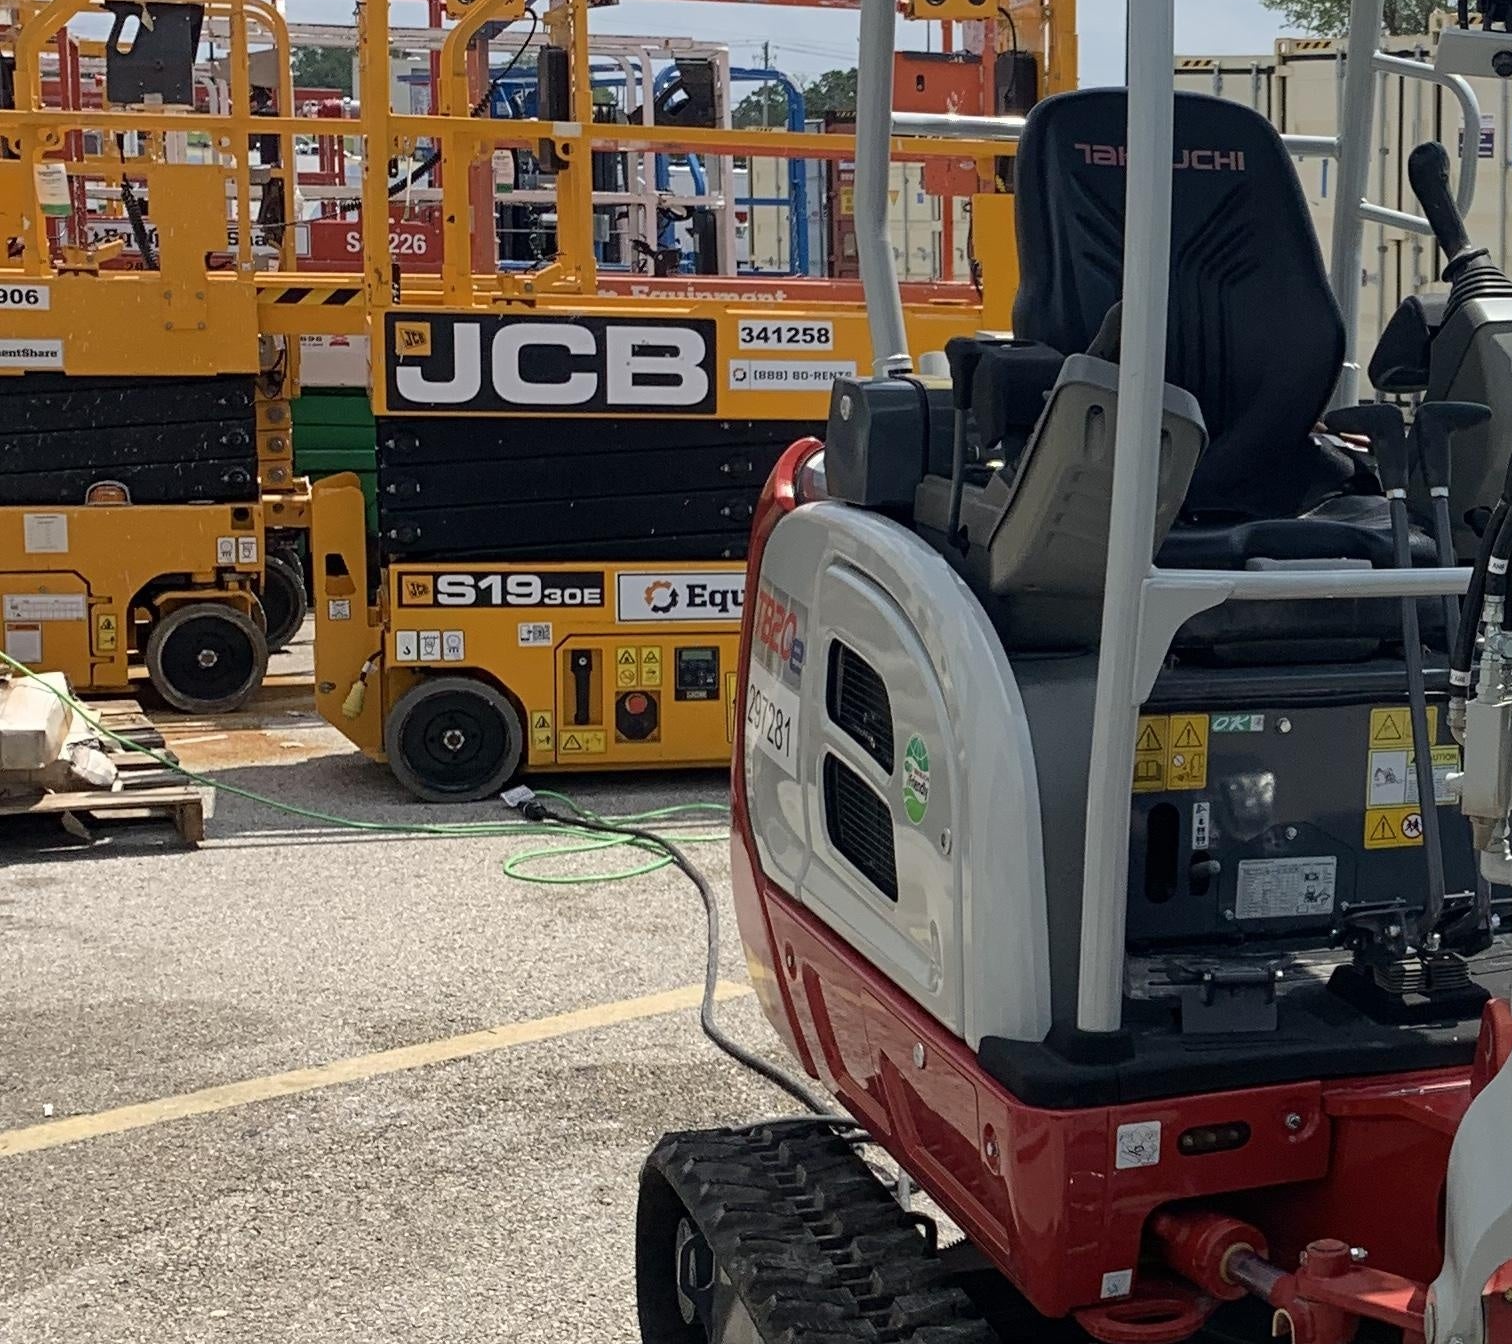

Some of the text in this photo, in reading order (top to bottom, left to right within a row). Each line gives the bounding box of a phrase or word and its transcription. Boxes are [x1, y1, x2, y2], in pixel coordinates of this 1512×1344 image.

[0, 348, 58, 358] entShare
[741, 327, 831, 344] 341258
[396, 322, 709, 405] JCB
[747, 683, 792, 757] 297281
